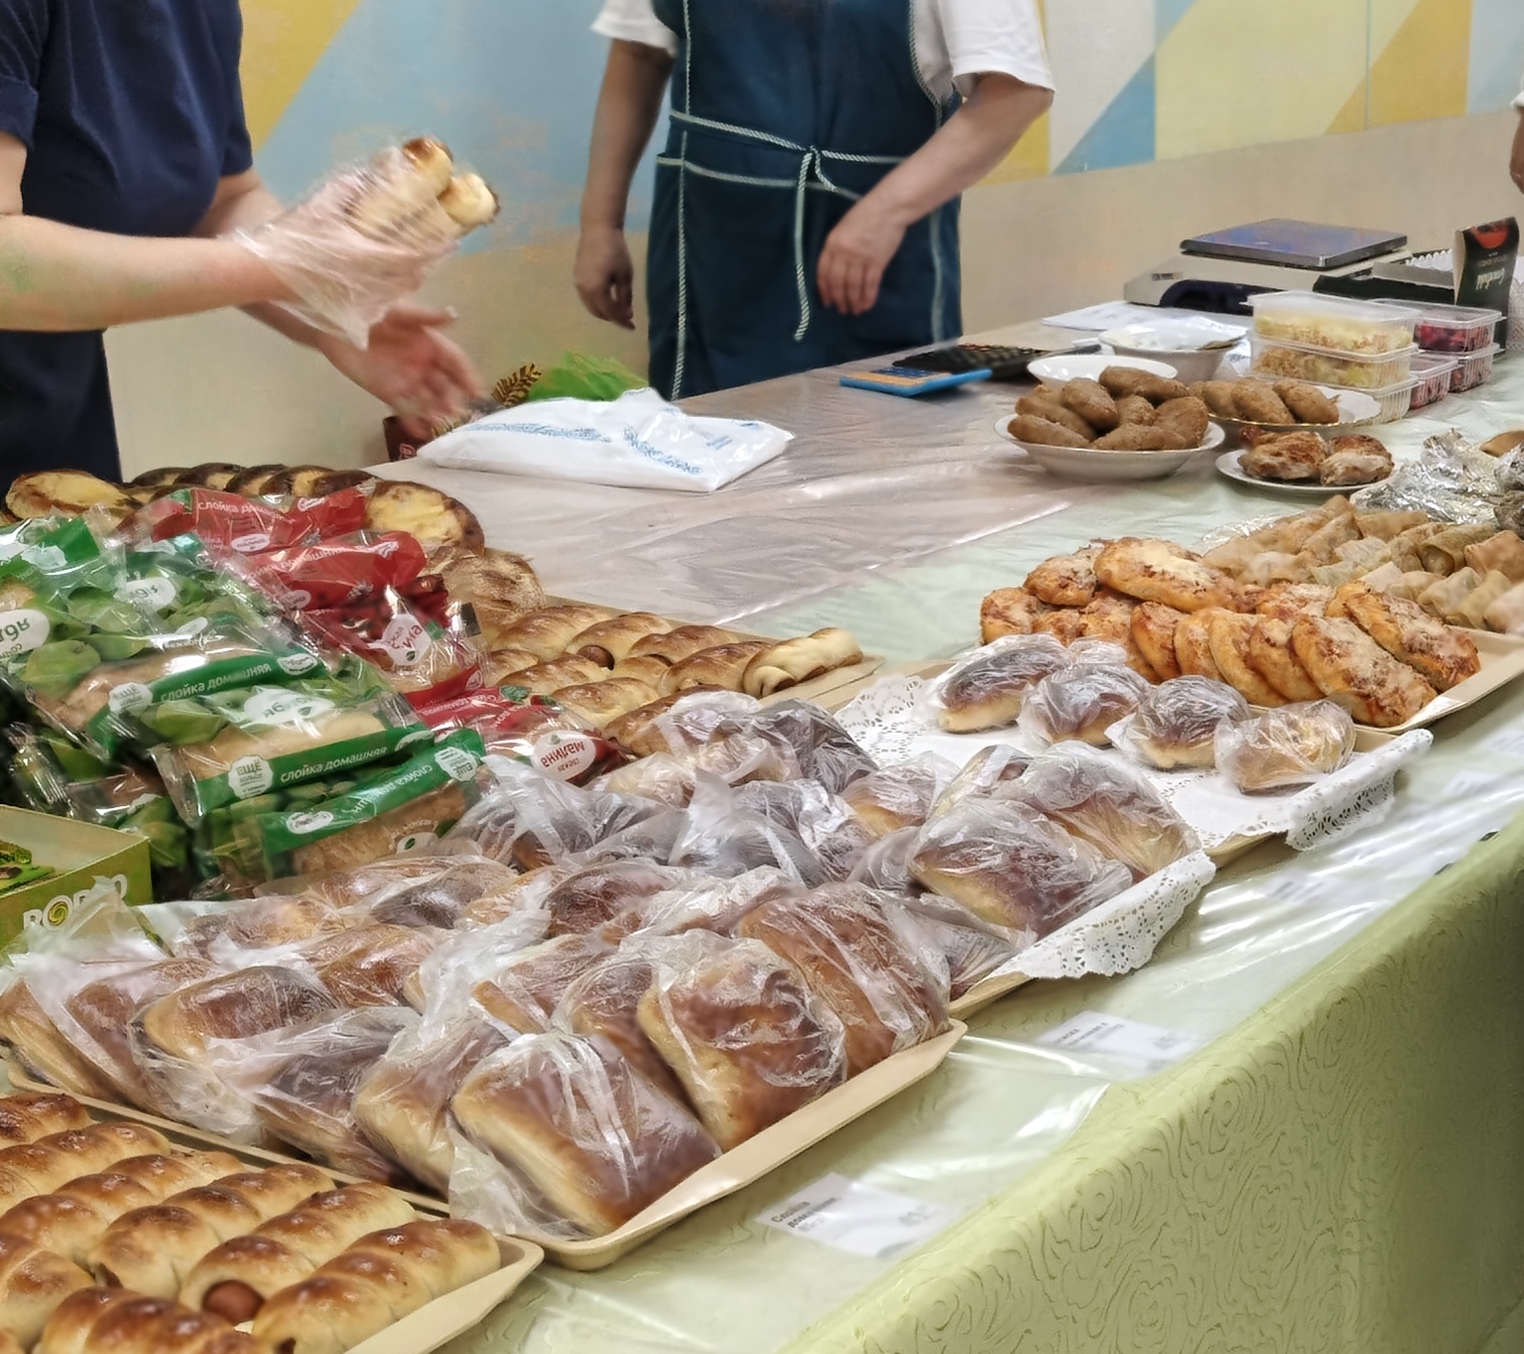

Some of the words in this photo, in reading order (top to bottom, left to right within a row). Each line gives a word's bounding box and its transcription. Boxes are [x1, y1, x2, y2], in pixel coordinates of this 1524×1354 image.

[160, 682, 206, 703] слойка
[206, 662, 273, 692] домшняя
[279, 762, 323, 784] слойка
[323, 745, 388, 773] домашняя
[540, 740, 586, 769] малина
